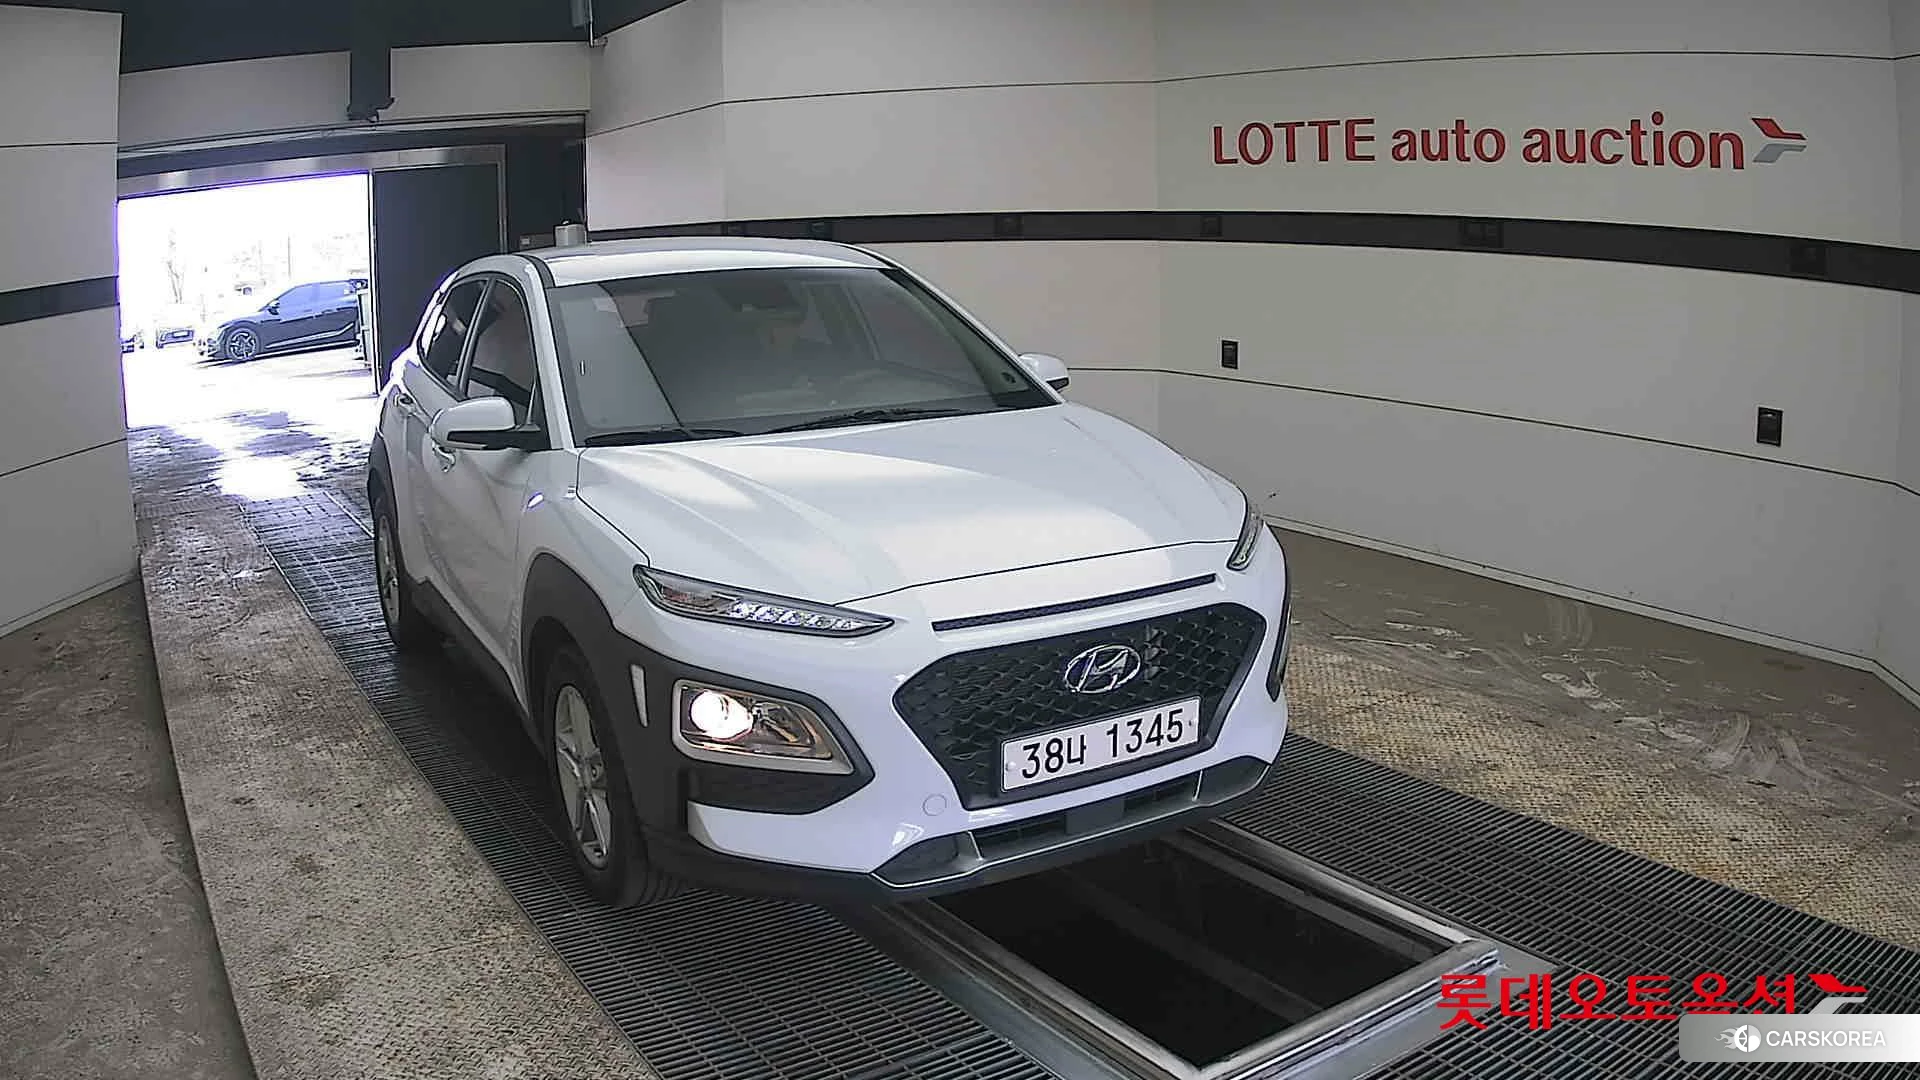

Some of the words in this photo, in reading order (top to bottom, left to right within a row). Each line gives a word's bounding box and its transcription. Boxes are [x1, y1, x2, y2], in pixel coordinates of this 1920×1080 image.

[1213, 118, 1376, 165] LOTTE
[1390, 119, 1506, 163] auto
[1522, 111, 1745, 170] auction
[1021, 734, 1087, 779] 38나
[1106, 708, 1183, 758] 1345
